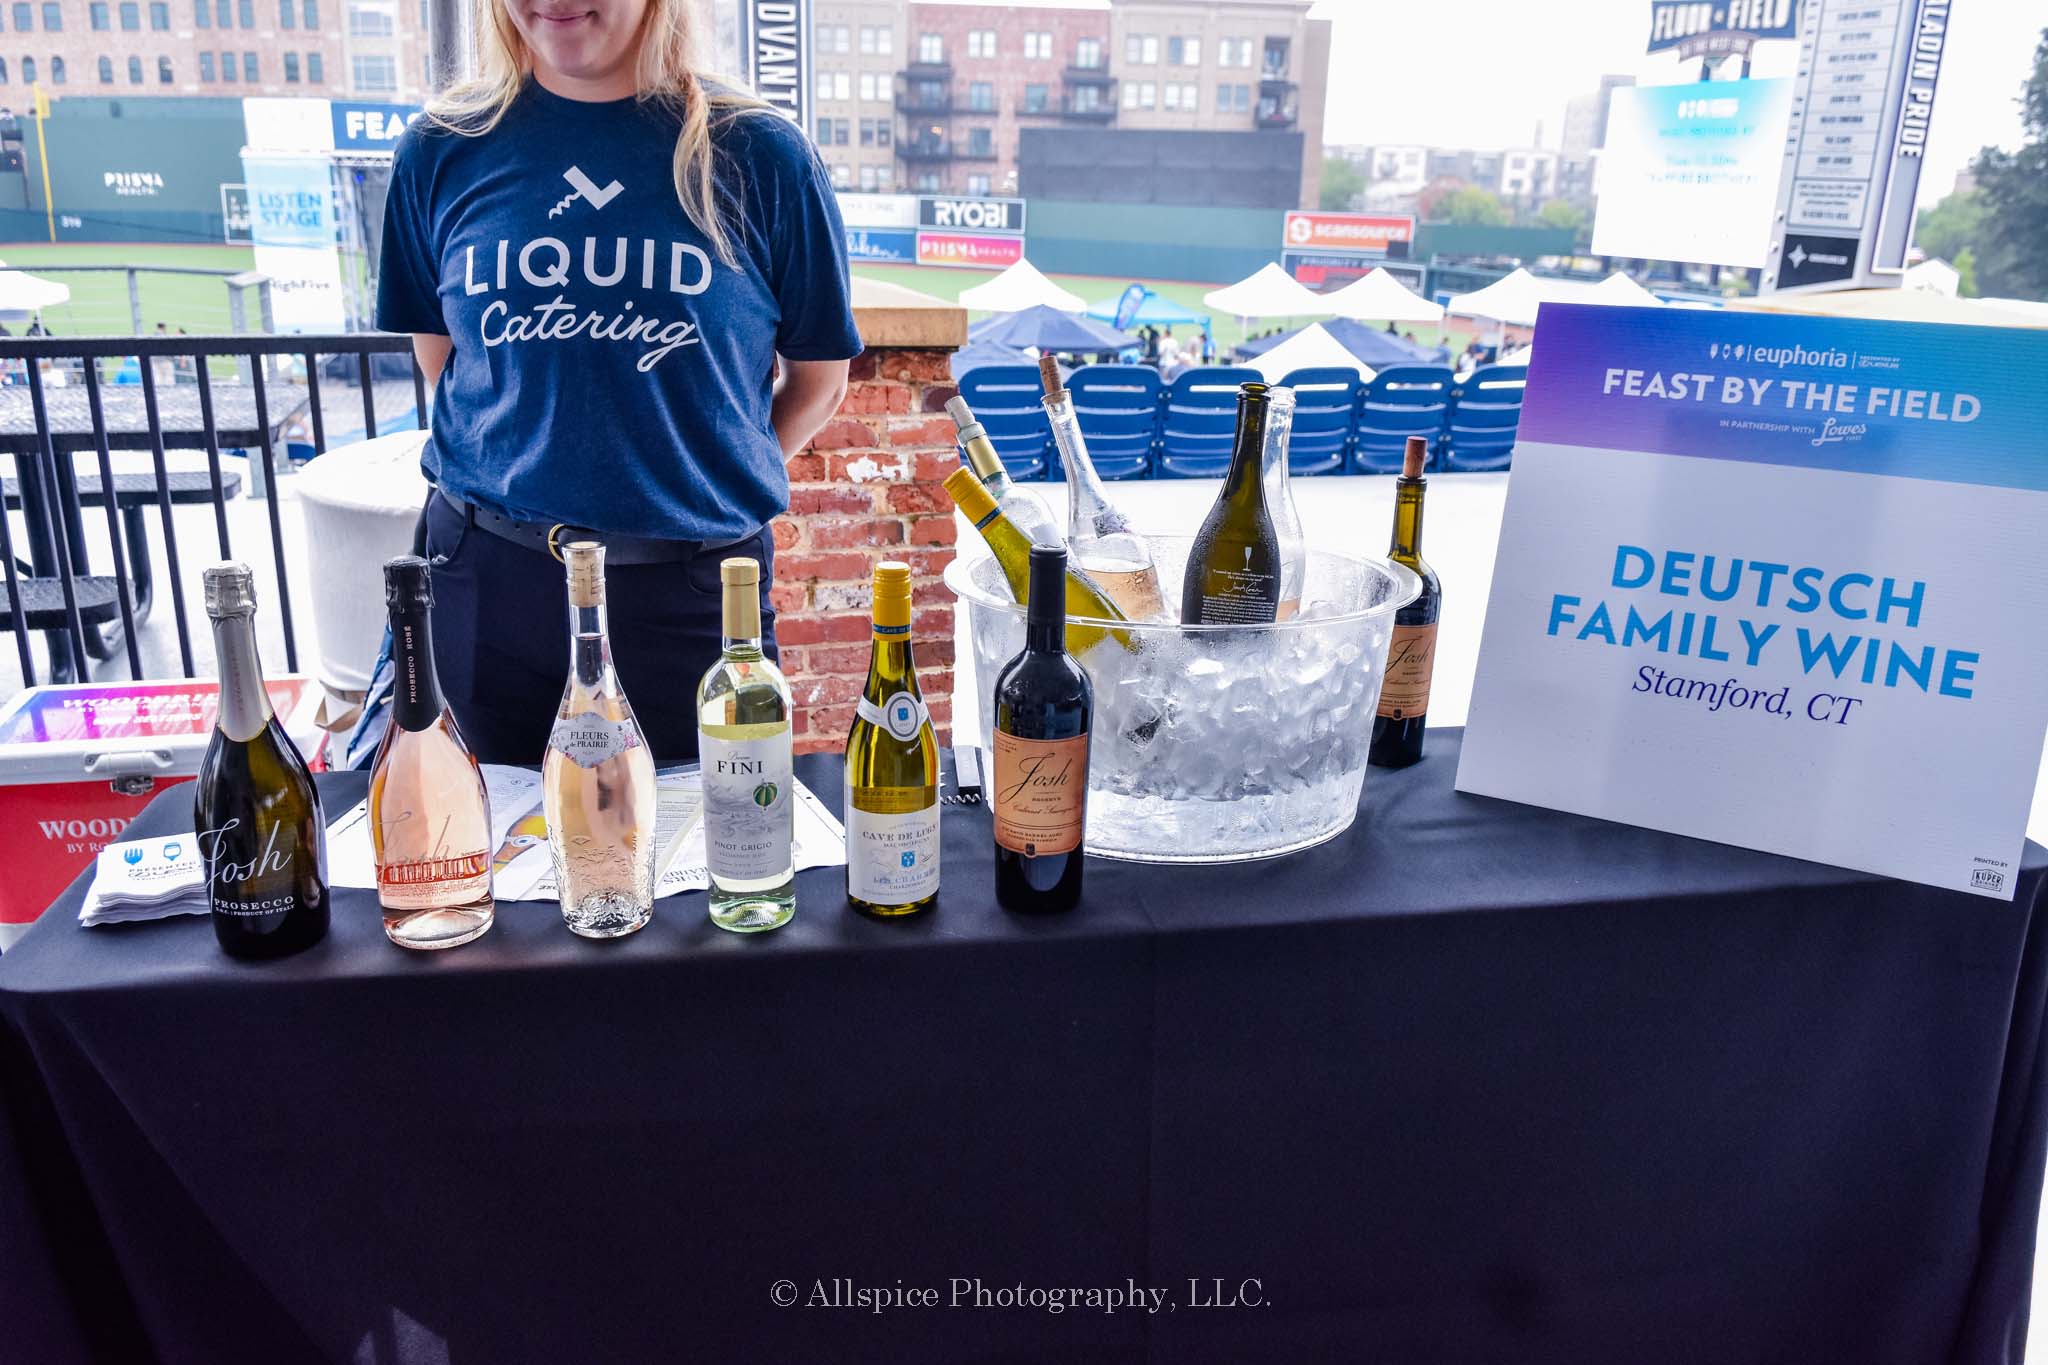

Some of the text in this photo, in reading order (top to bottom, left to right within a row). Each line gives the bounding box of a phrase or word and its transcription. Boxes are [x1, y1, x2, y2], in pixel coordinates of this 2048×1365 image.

[1898, 86, 1936, 158] PRIDE
[258, 191, 322, 209] LISTEN
[261, 210, 322, 227] STAGE
[933, 200, 1009, 228] RYOBI
[465, 236, 712, 297] LIQUID
[480, 294, 700, 373] Catering
[1754, 344, 1848, 369] euphoria
[1603, 368, 1982, 424] FEAST BY THE FIELD
[1731, 421, 1790, 432] PARTNERSHIP
[1791, 426, 1816, 434] WITH
[1611, 544, 1926, 628] DEUTSCH
[1547, 593, 1980, 699] FAMILY WINE
[408, 656, 417, 703] PROSECCO
[1632, 665, 1863, 726] Stamford, CT
[570, 731, 609, 740] FLEURS
[717, 760, 764, 775] FINI
[998, 752, 1073, 804] Josh
[38, 815, 137, 841] WOOD
[862, 831, 895, 841] CAVE
[898, 831, 913, 841] DE
[66, 843, 85, 854] BY
[714, 841, 772, 851] PINOT GRIGIO
[197, 817, 292, 914] Josh
[1974, 857, 1999, 866] PRINTED
[1975, 871, 2002, 884] KUPER
[214, 896, 294, 910] PROSECCO
[276, 904, 295, 912] ITALY
